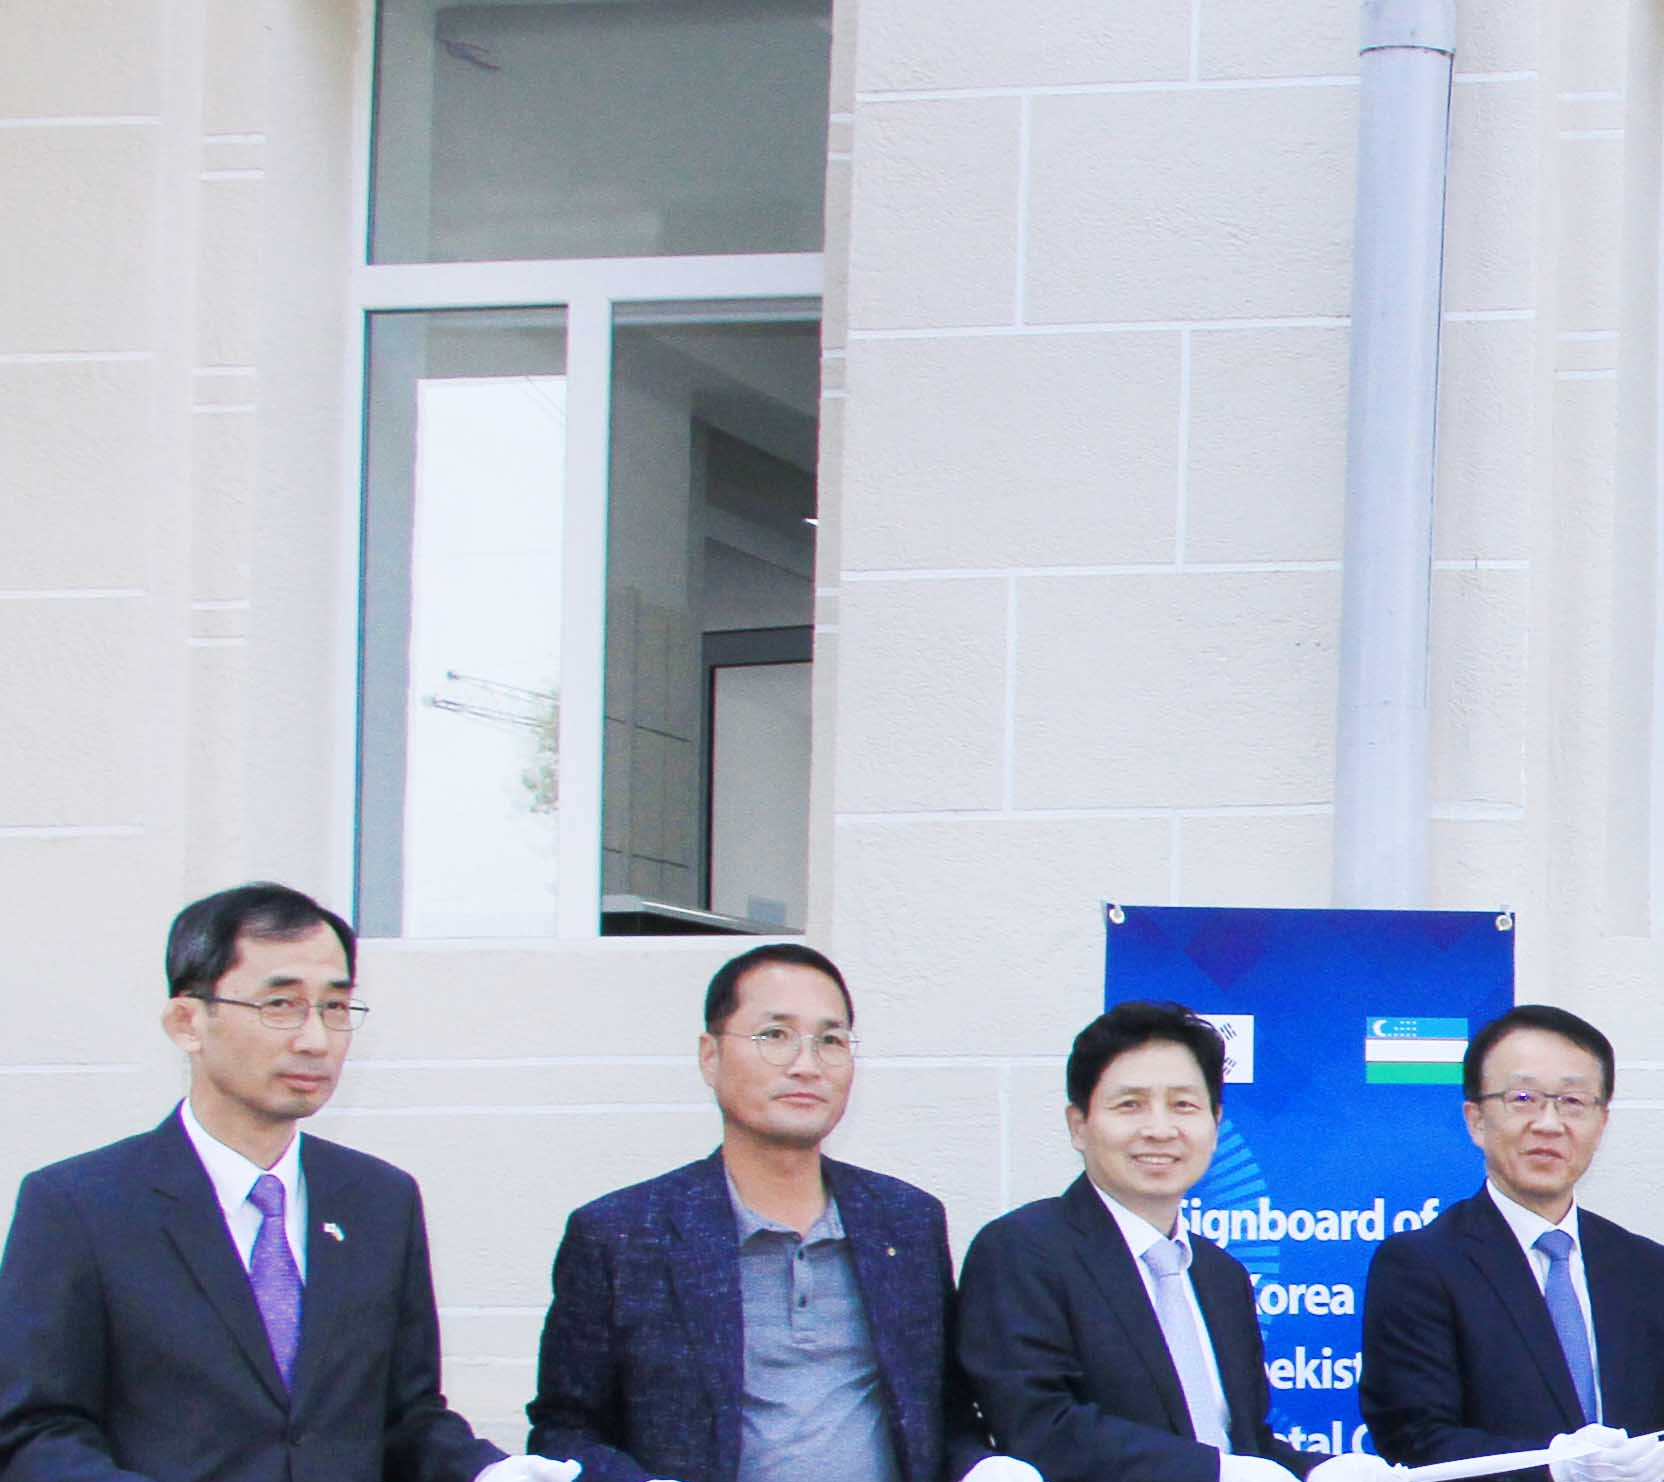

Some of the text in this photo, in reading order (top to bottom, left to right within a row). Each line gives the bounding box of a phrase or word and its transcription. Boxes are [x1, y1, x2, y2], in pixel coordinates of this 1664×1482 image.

[1393, 1198, 1440, 1233] of
[1250, 1274, 1355, 1315] orea
[1273, 1420, 1343, 1456] tal
